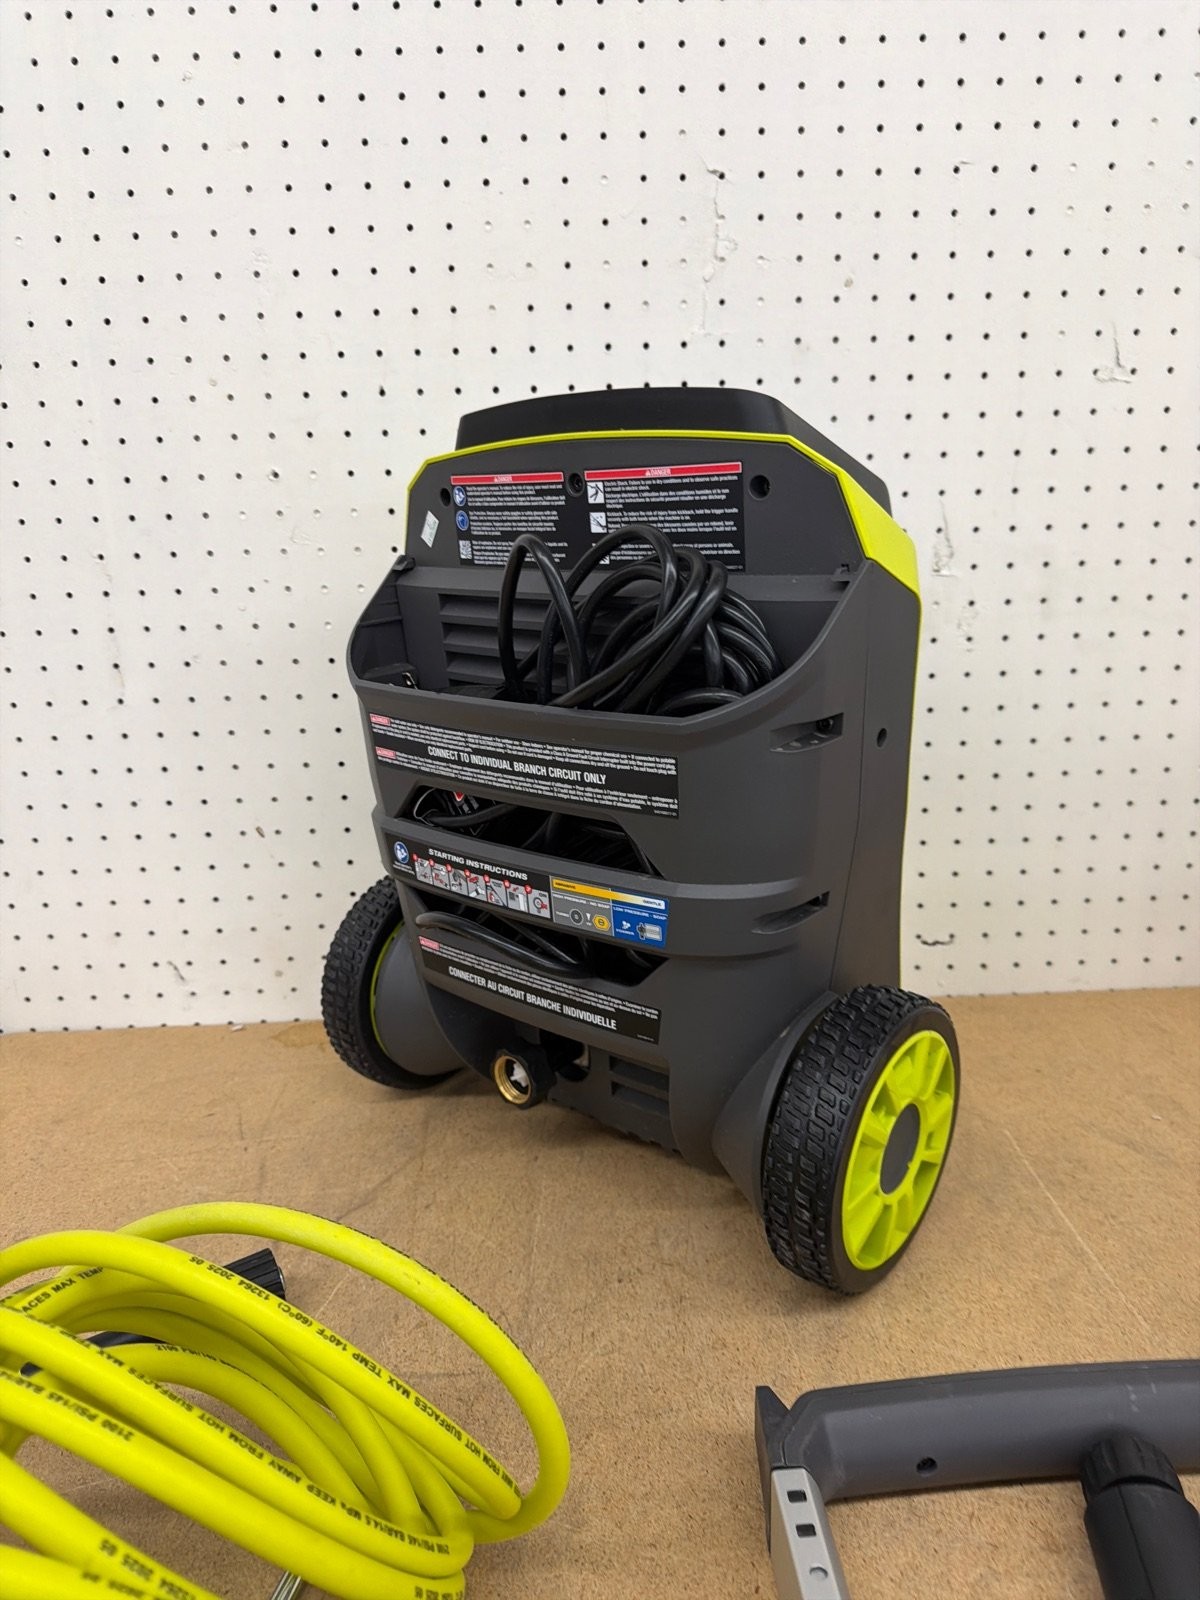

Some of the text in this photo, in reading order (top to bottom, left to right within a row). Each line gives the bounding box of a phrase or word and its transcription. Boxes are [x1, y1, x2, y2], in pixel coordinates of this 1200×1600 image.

[427, 745, 458, 761] CONNECT
[459, 752, 469, 763] TO
[470, 754, 512, 771] INDIVIDUAL
[513, 761, 547, 776] BRANCH
[548, 766, 582, 782] CIRCUIT
[584, 772, 607, 785] ONLY
[428, 848, 465, 865] STARTING
[466, 859, 528, 881] INSTRUCTIONS
[448, 965, 487, 988] CONNECTER
[487, 980, 497, 991] AU
[498, 983, 526, 1001] CIRCUIT
[526, 992, 562, 1013] BRANCHE
[562, 1004, 617, 1030] INDIVIDUELLE
[189, 1256, 205, 1266] 05
[206, 1264, 235, 1281] 2025
[51, 1277, 77, 1293] MAX
[238, 1280, 271, 1301] 13264
[278, 1301, 313, 1328] (60°C)
[316, 1326, 349, 1352] 140°F
[352, 1352, 382, 1379] TEMP
[127, 1368, 194, 1412] SURFACES
[386, 1374, 412, 1399] MAX
[198, 1412, 226, 1434] HOT
[414, 1396, 463, 1441] SURFACES
[228, 1431, 264, 1460] FROM
[464, 1437, 482, 1459] HOT
[268, 1459, 302, 1484] AWAY
[306, 1483, 337, 1506] KEEP
